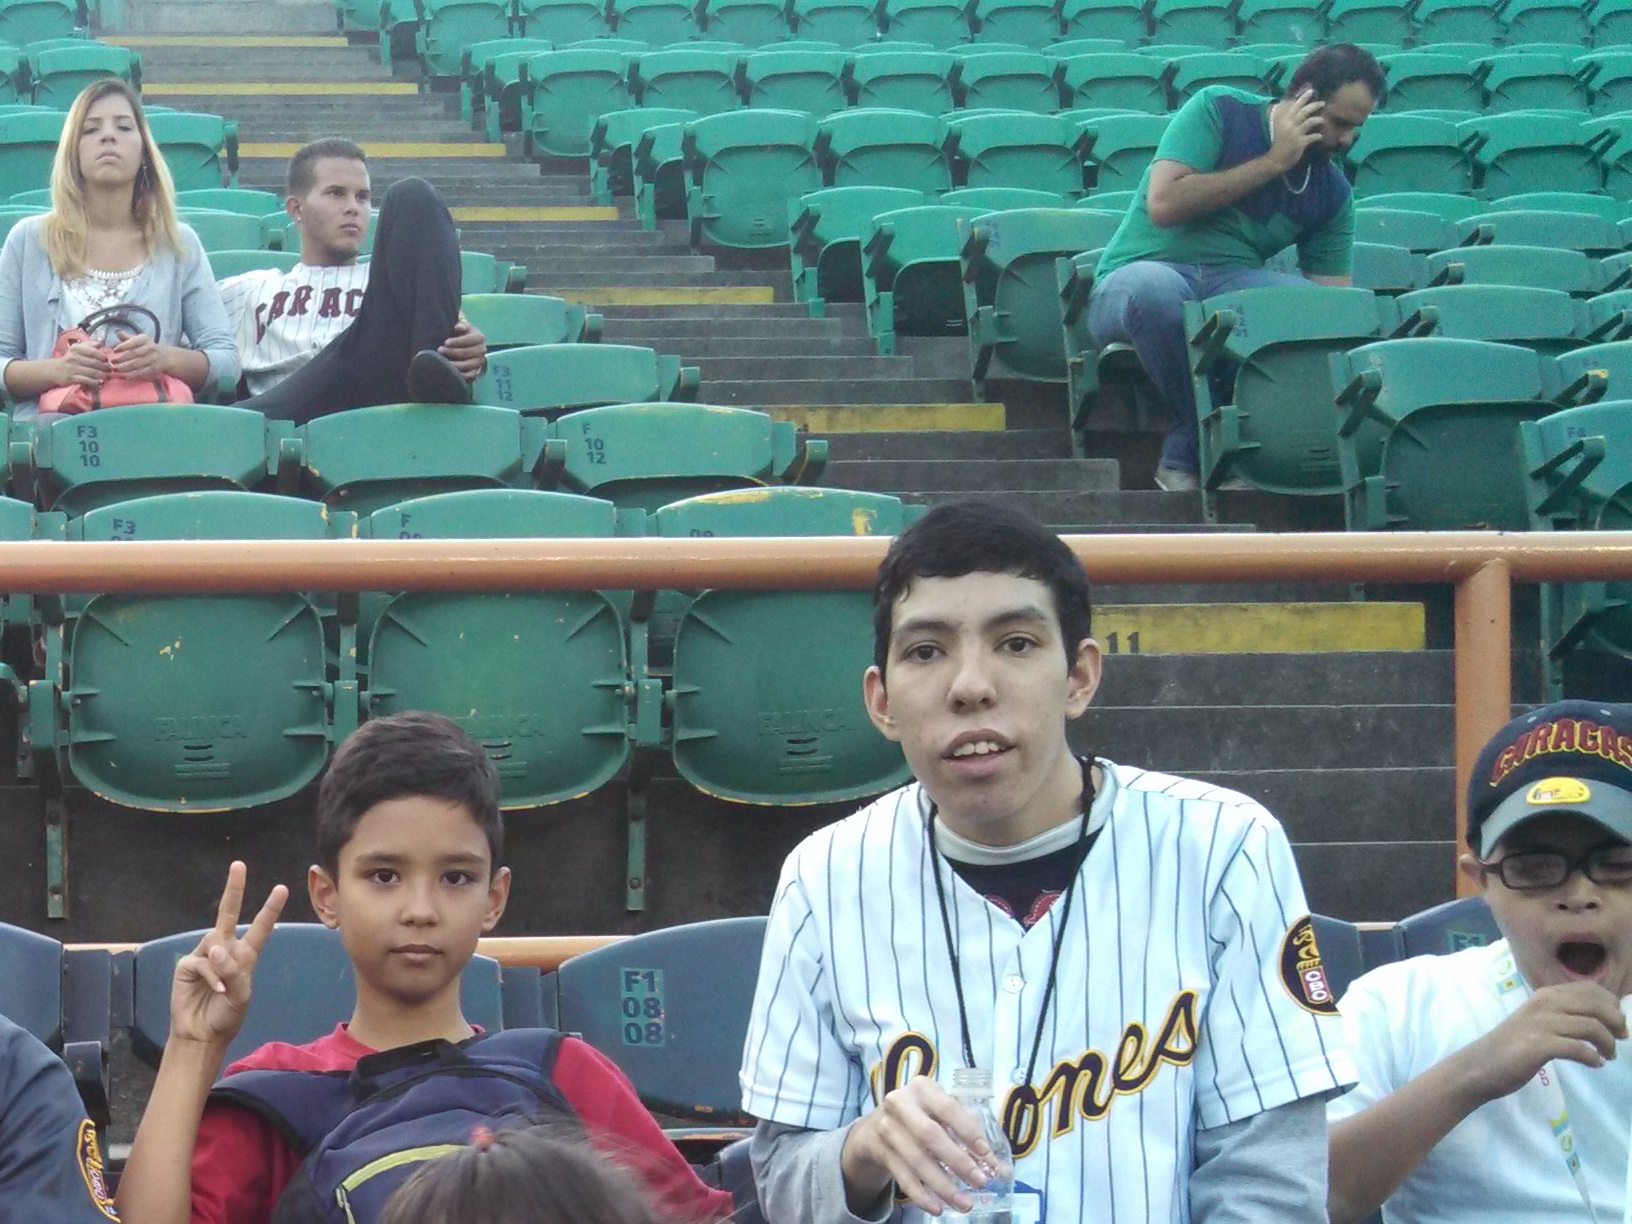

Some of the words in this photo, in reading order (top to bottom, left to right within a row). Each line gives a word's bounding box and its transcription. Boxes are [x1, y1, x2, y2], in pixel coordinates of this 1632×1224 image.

[493, 365, 510, 377] F3
[496, 379, 511, 390] 11
[497, 390, 513, 401] 12
[77, 425, 98, 438] F3
[582, 422, 591, 435] F
[79, 440, 99, 453] 10
[584, 437, 604, 451] 10
[80, 454, 100, 467] 10
[586, 451, 607, 465] 12
[112, 518, 136, 535] F3
[401, 513, 411, 528] F
[1106, 632, 1141, 654] 11
[625, 970, 655, 992] F1
[623, 997, 661, 1019] 08
[625, 1022, 662, 1045] 08
[870, 988, 1198, 1200] Lones
